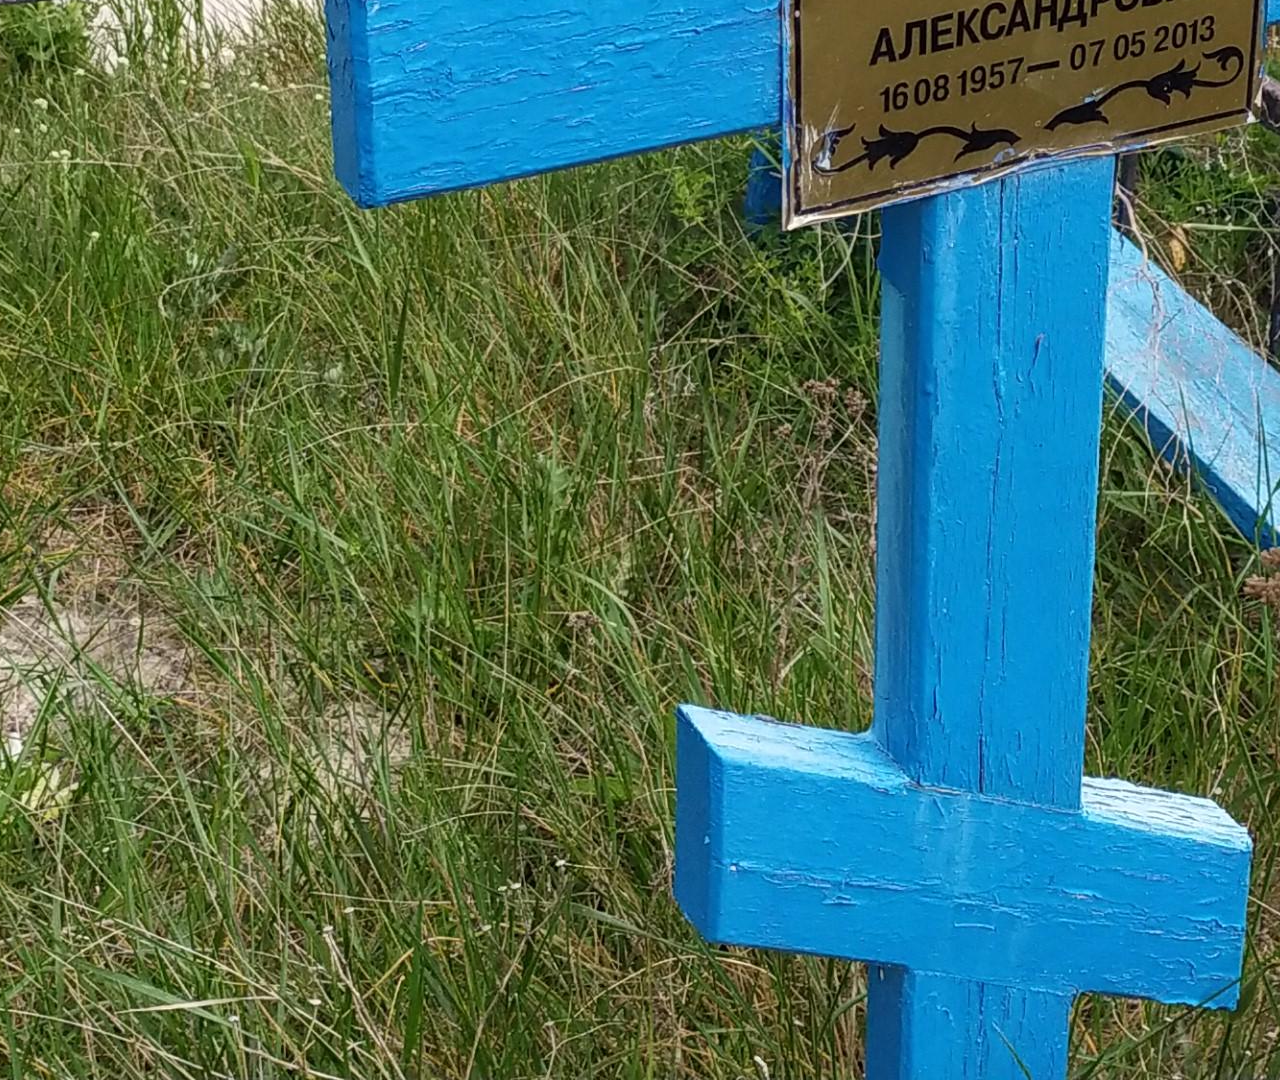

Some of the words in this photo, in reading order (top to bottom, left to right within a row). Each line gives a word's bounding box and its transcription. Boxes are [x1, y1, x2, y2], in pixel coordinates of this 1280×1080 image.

[880, 88, 908, 113] 16
[914, 78, 950, 106] 08
[1070, 40, 1103, 71] 07
[1113, 29, 1147, 59] 05
[1154, 16, 1215, 53] 2013
